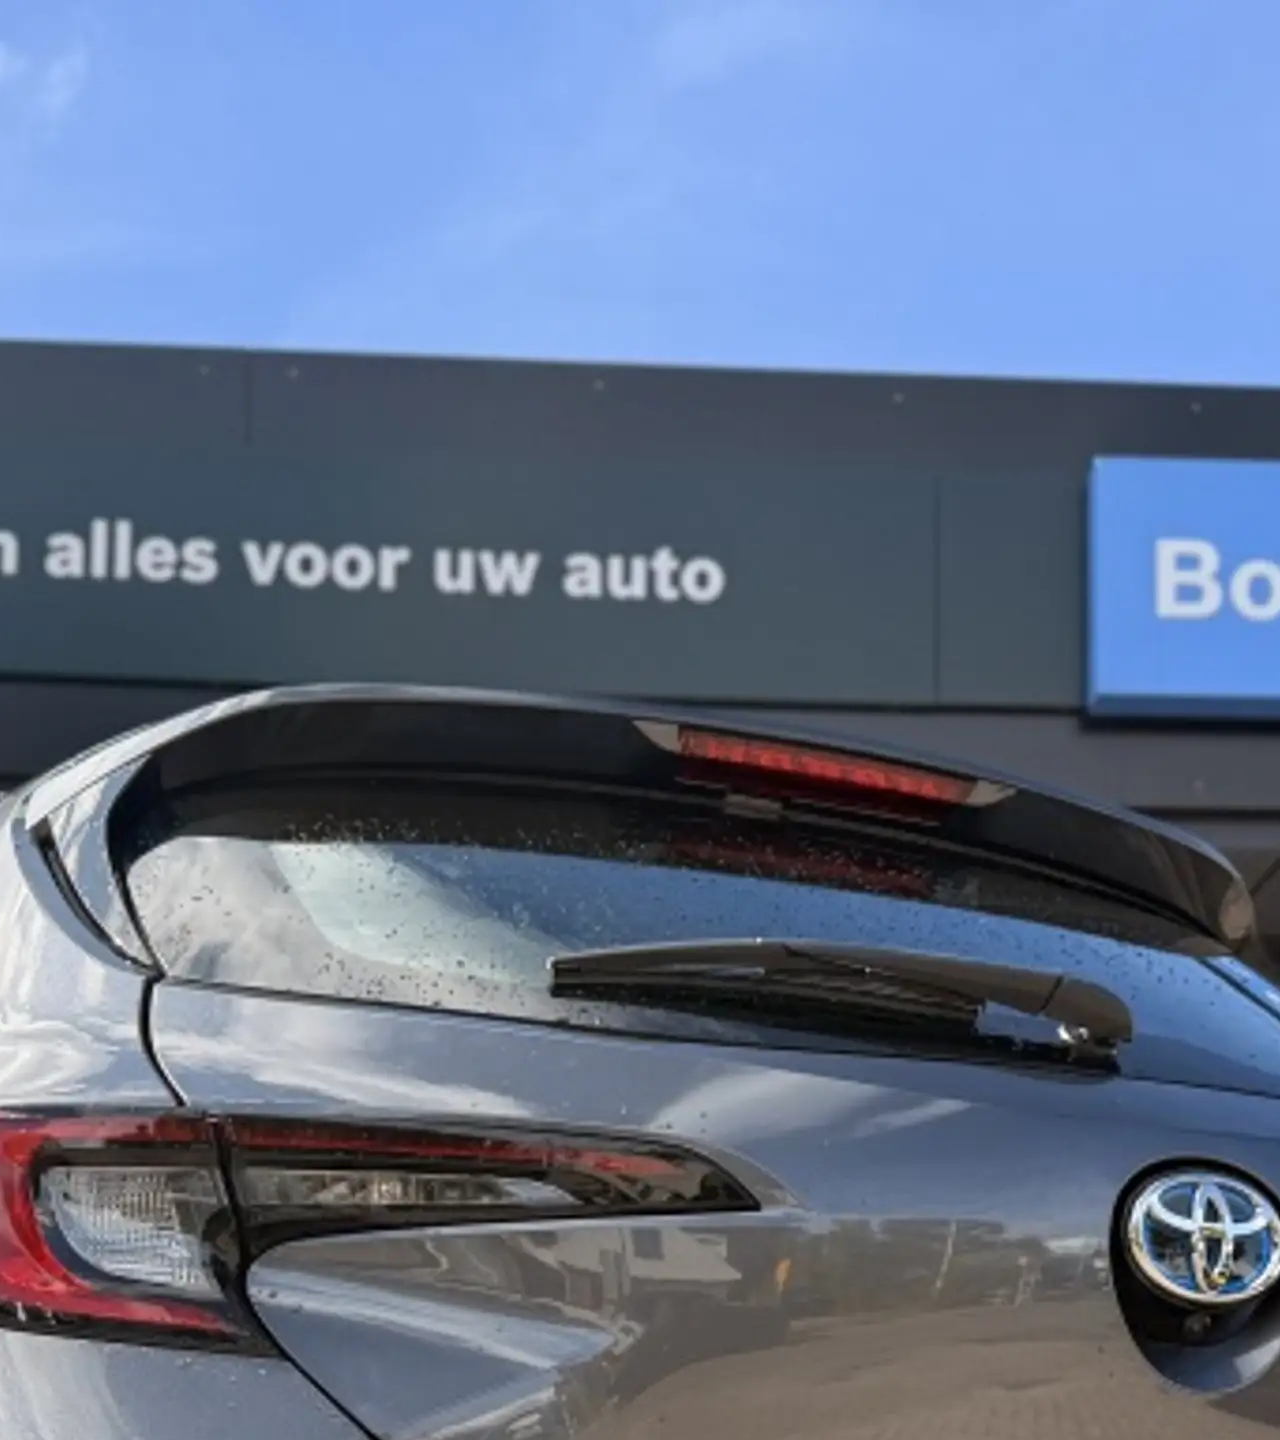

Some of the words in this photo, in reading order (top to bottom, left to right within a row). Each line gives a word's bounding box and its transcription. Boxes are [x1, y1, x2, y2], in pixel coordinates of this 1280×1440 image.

[43, 517, 219, 584] alles
[241, 540, 412, 592] voor
[433, 547, 541, 597] uw
[562, 546, 726, 603] auto
